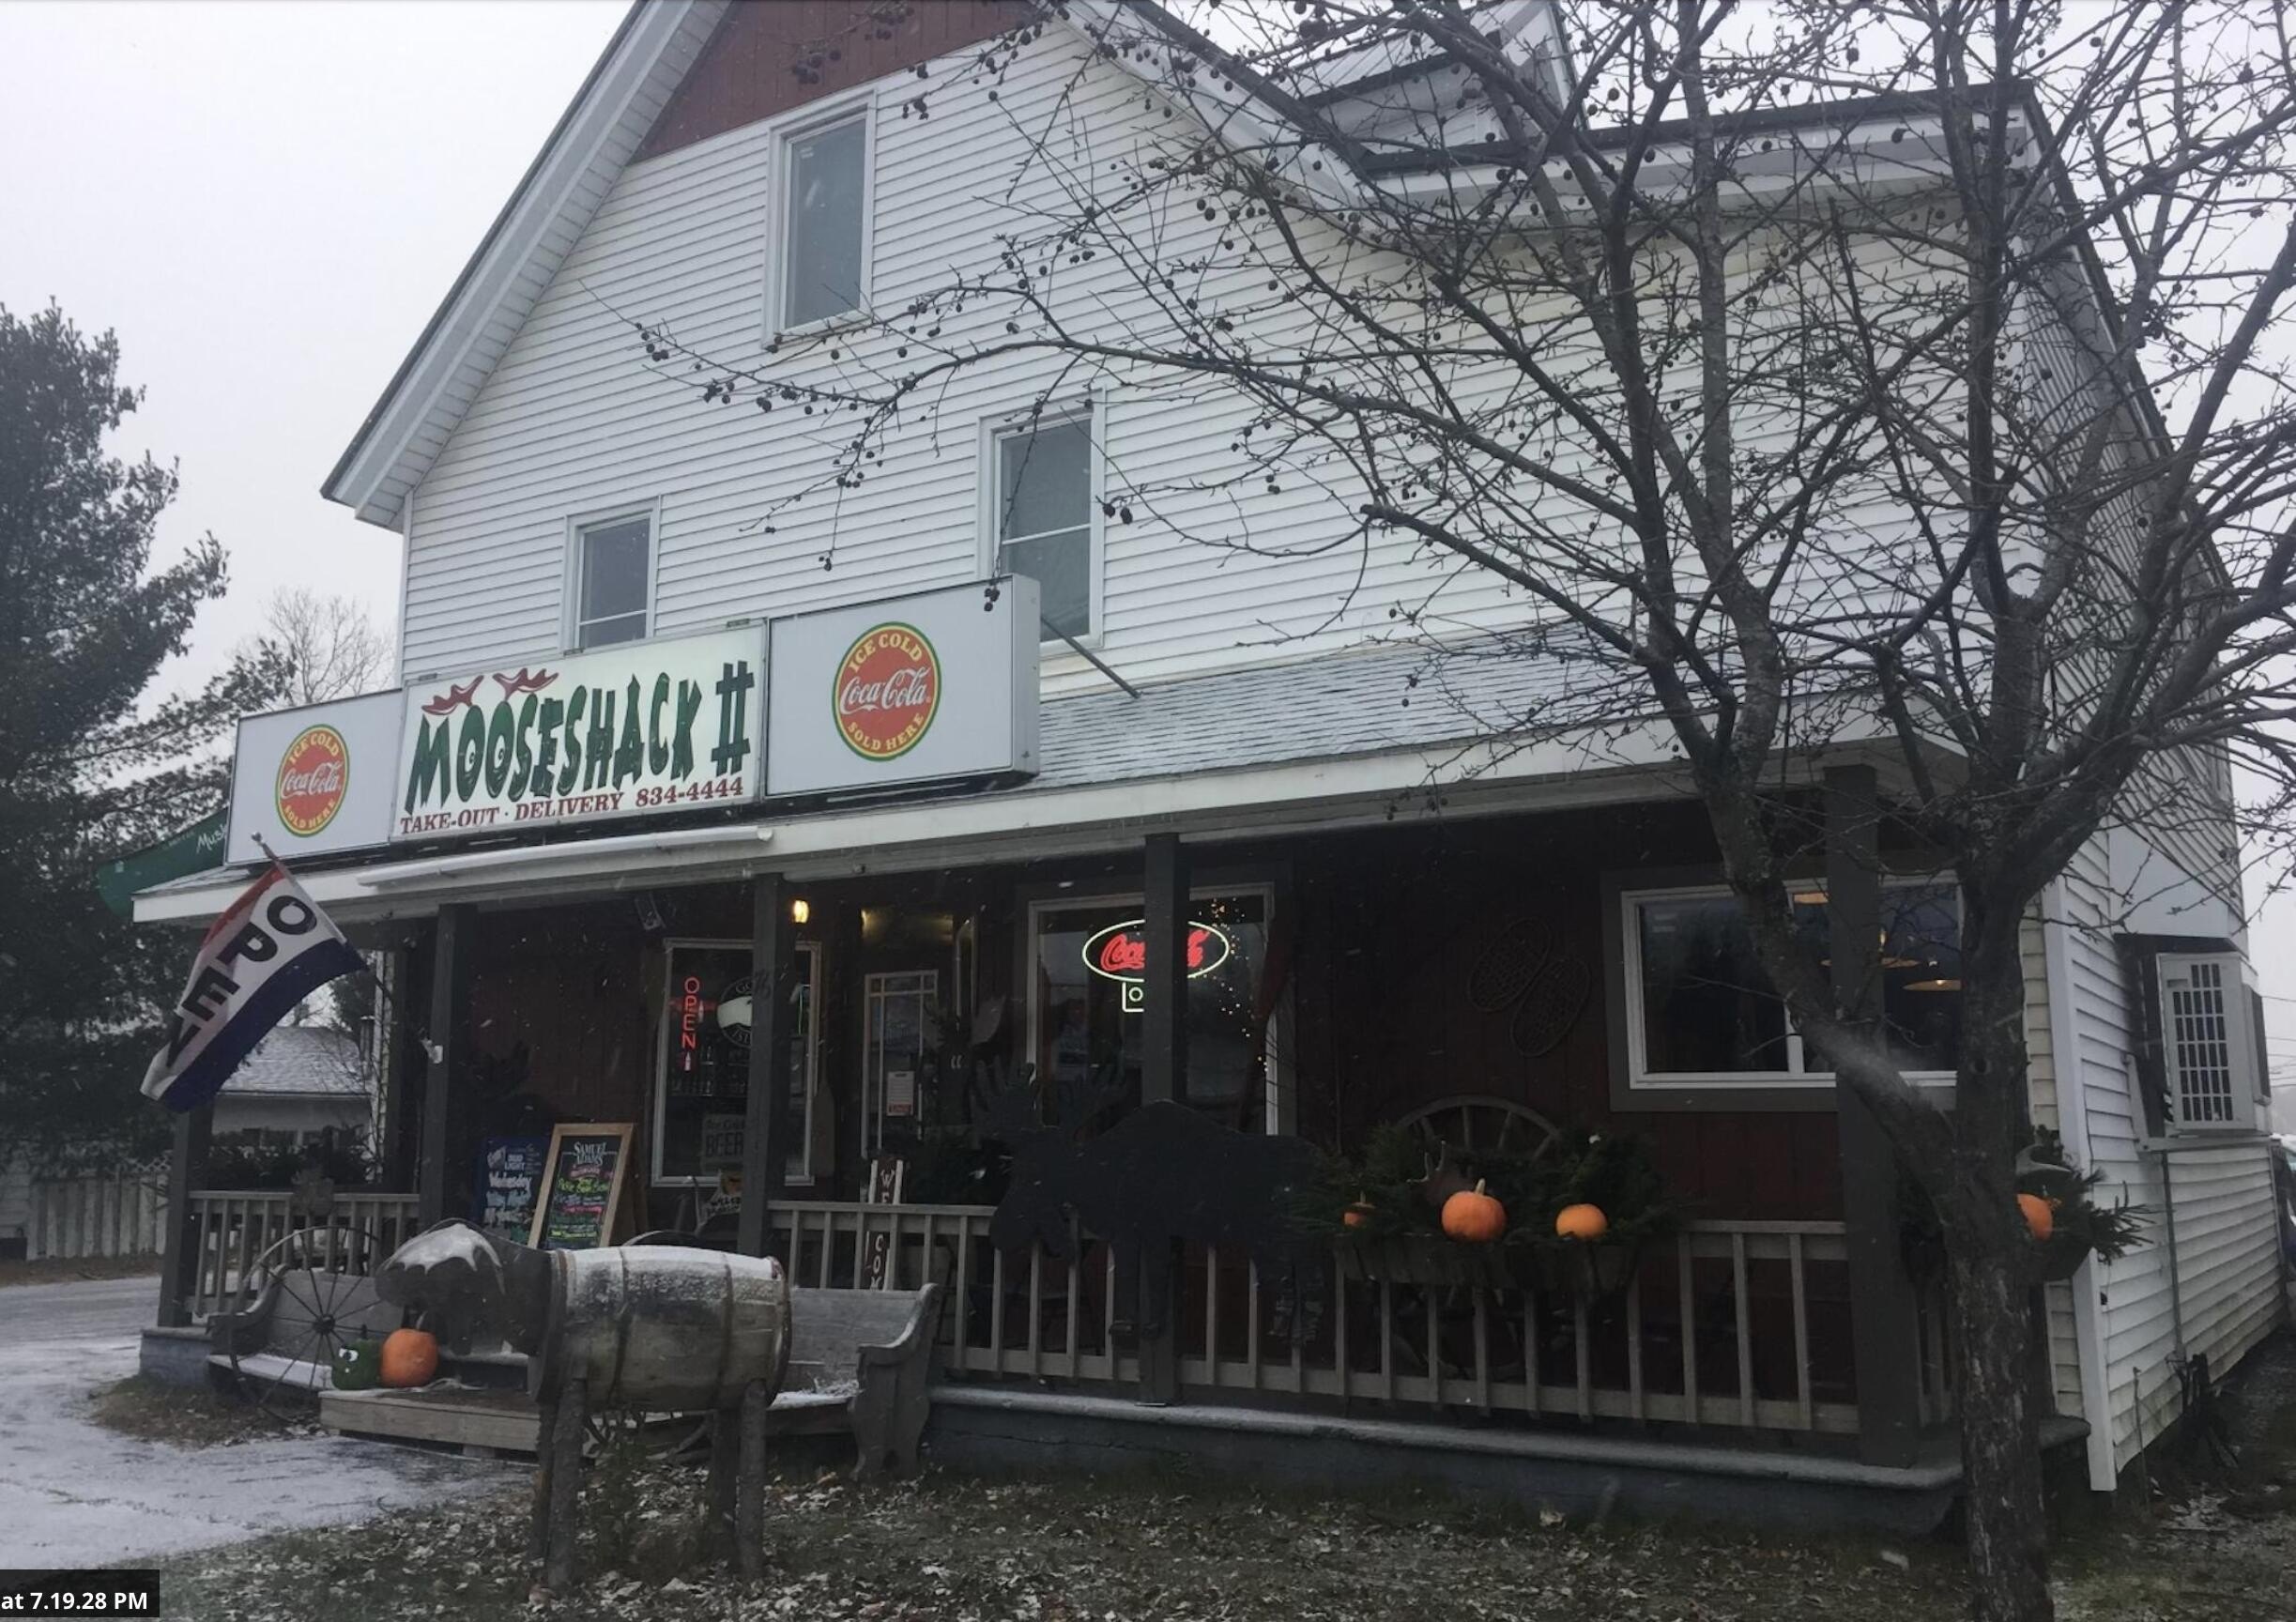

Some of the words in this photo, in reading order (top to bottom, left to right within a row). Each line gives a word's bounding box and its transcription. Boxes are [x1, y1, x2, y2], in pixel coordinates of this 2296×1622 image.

[849, 639, 876, 672] ICE
[879, 633, 923, 662] COLD
[840, 666, 932, 715] Coca-Cola
[289, 738, 309, 765] ICE
[311, 732, 340, 757] COLD
[405, 671, 702, 816] MOOSESHACK
[848, 721, 881, 751] SOLD
[885, 712, 925, 751] HERE
[282, 760, 344, 800] Coca-Cola
[284, 805, 306, 828] SOLD
[308, 799, 335, 829] HERE
[400, 806, 500, 834] TAKE-OUT
[515, 792, 623, 821] DELIVERY
[635, 776, 744, 808] 834-4444
[681, 976, 701, 1049] OPEN
